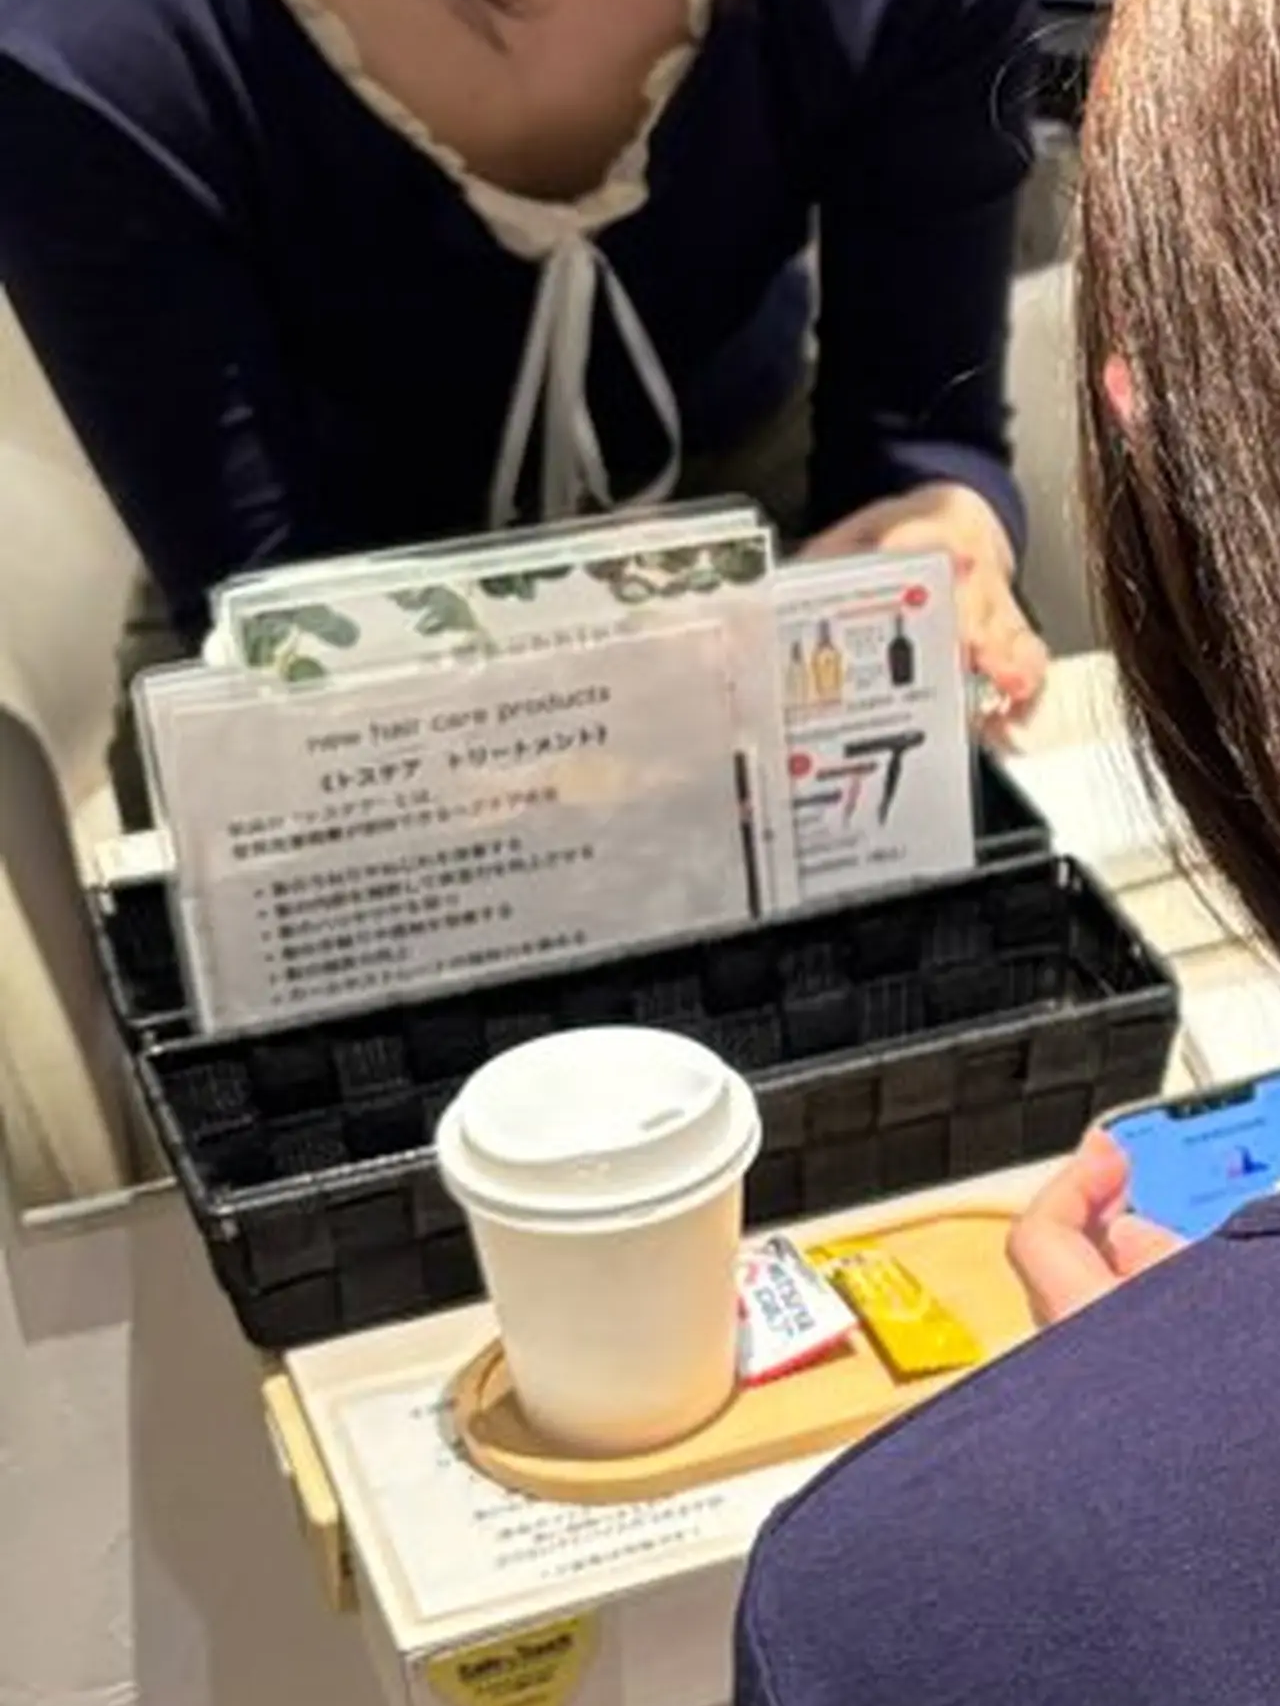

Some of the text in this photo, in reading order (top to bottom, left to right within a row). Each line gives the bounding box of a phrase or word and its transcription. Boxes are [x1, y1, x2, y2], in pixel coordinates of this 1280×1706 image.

[306, 685, 611, 755] new hair care products
